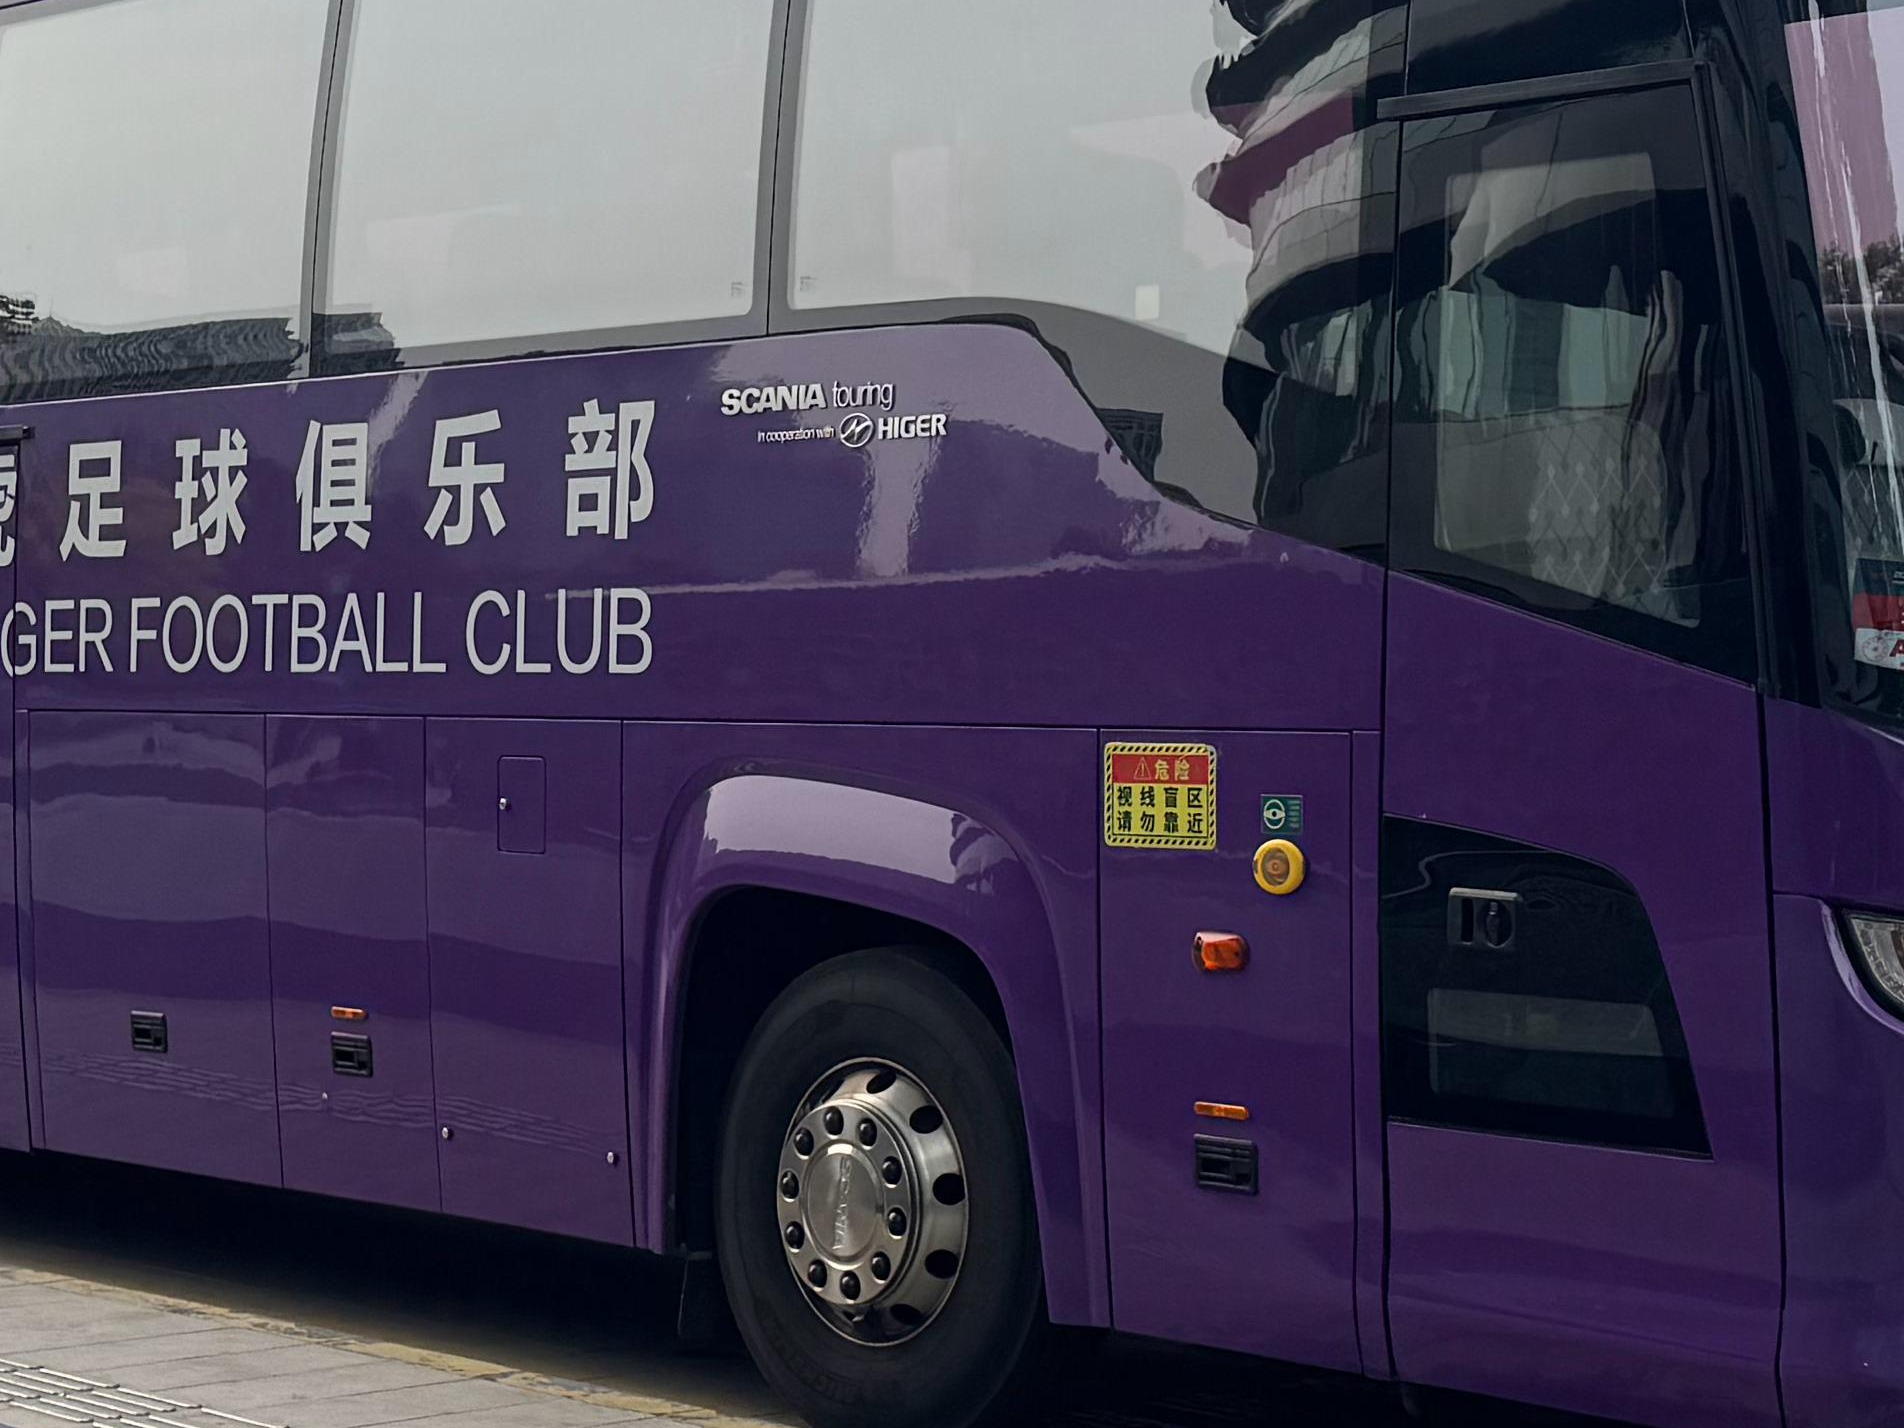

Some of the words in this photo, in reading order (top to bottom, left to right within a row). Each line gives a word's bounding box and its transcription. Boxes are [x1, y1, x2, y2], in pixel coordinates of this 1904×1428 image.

[720, 383, 827, 416] SCANIA
[832, 380, 894, 412] touring
[878, 413, 947, 440] HIGER
[129, 591, 448, 673] FOOTBALL
[465, 587, 653, 674] CLUB
[1154, 759, 1191, 781] 危险
[1116, 785, 1204, 809] 视线盲区
[1116, 810, 1204, 834] 请勿靠近
